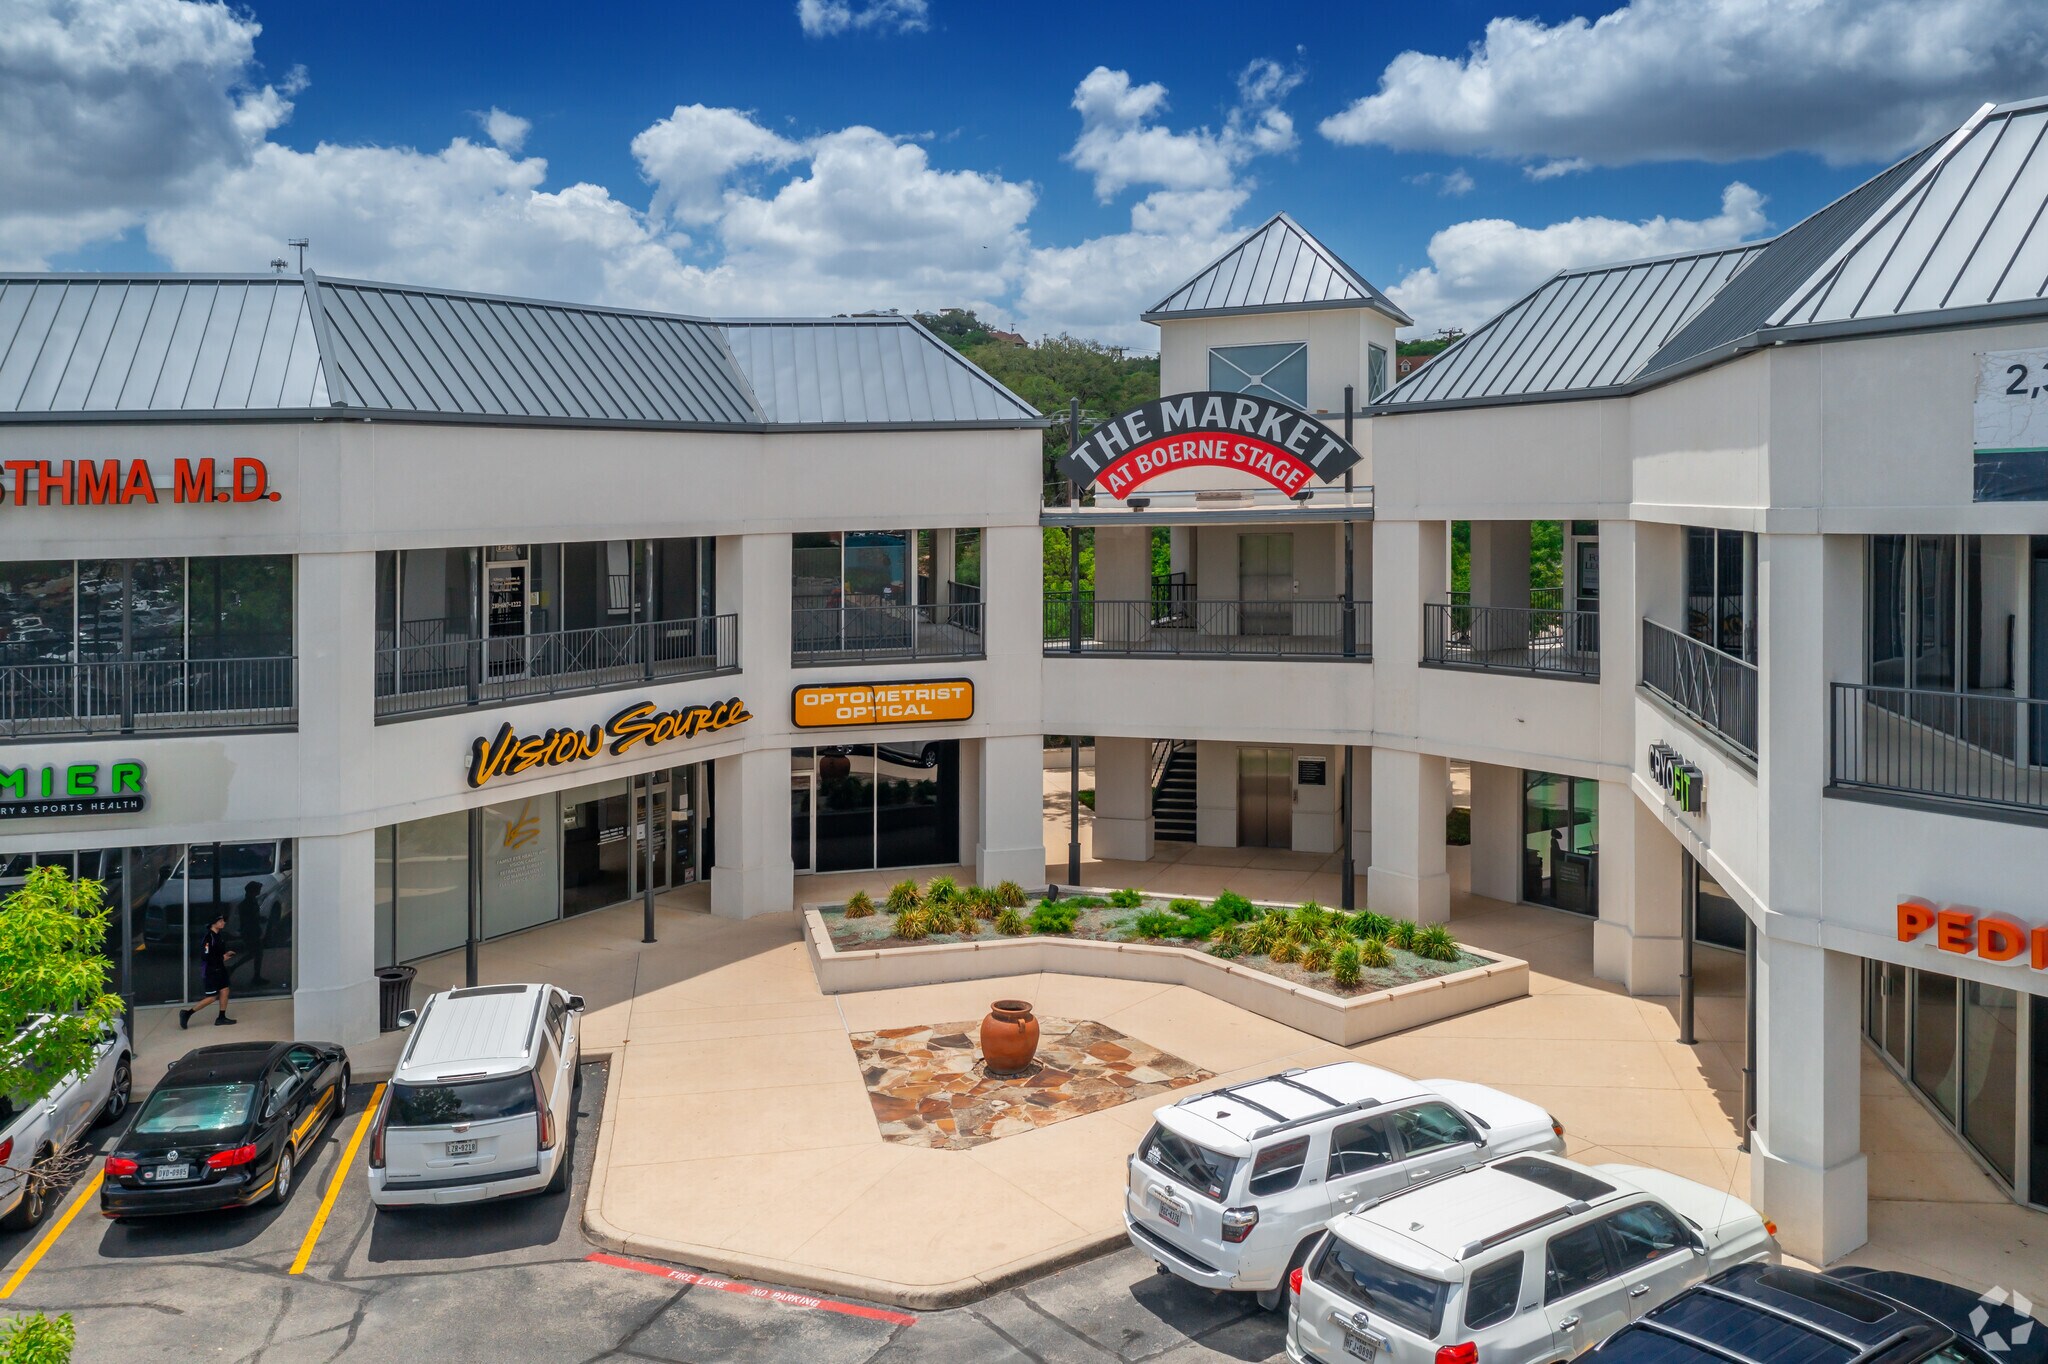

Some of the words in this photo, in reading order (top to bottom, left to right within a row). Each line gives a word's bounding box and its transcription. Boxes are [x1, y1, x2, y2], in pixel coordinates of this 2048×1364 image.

[2005, 363, 2048, 399] 2,
[1071, 409, 1153, 473] THE
[1160, 396, 1344, 468] MARKET
[1107, 462, 1134, 493] AT
[1136, 440, 1227, 475] BOERNE
[1232, 443, 1304, 490] STAGE
[0, 459, 158, 505] THMA
[174, 457, 281, 503] M.D.
[803, 687, 965, 706] OPTOMETRIST
[836, 703, 933, 719] OPTICAL
[1648, 744, 1695, 812] CRYOFIT
[21, 806, 28, 814] &
[34, 803, 83, 813] SPORTS
[91, 800, 138, 811] HEALTH
[668, 1271, 696, 1282] FIRE
[696, 1276, 728, 1289] LANE
[751, 1288, 768, 1296] NO
[773, 1292, 821, 1308] PARKING
